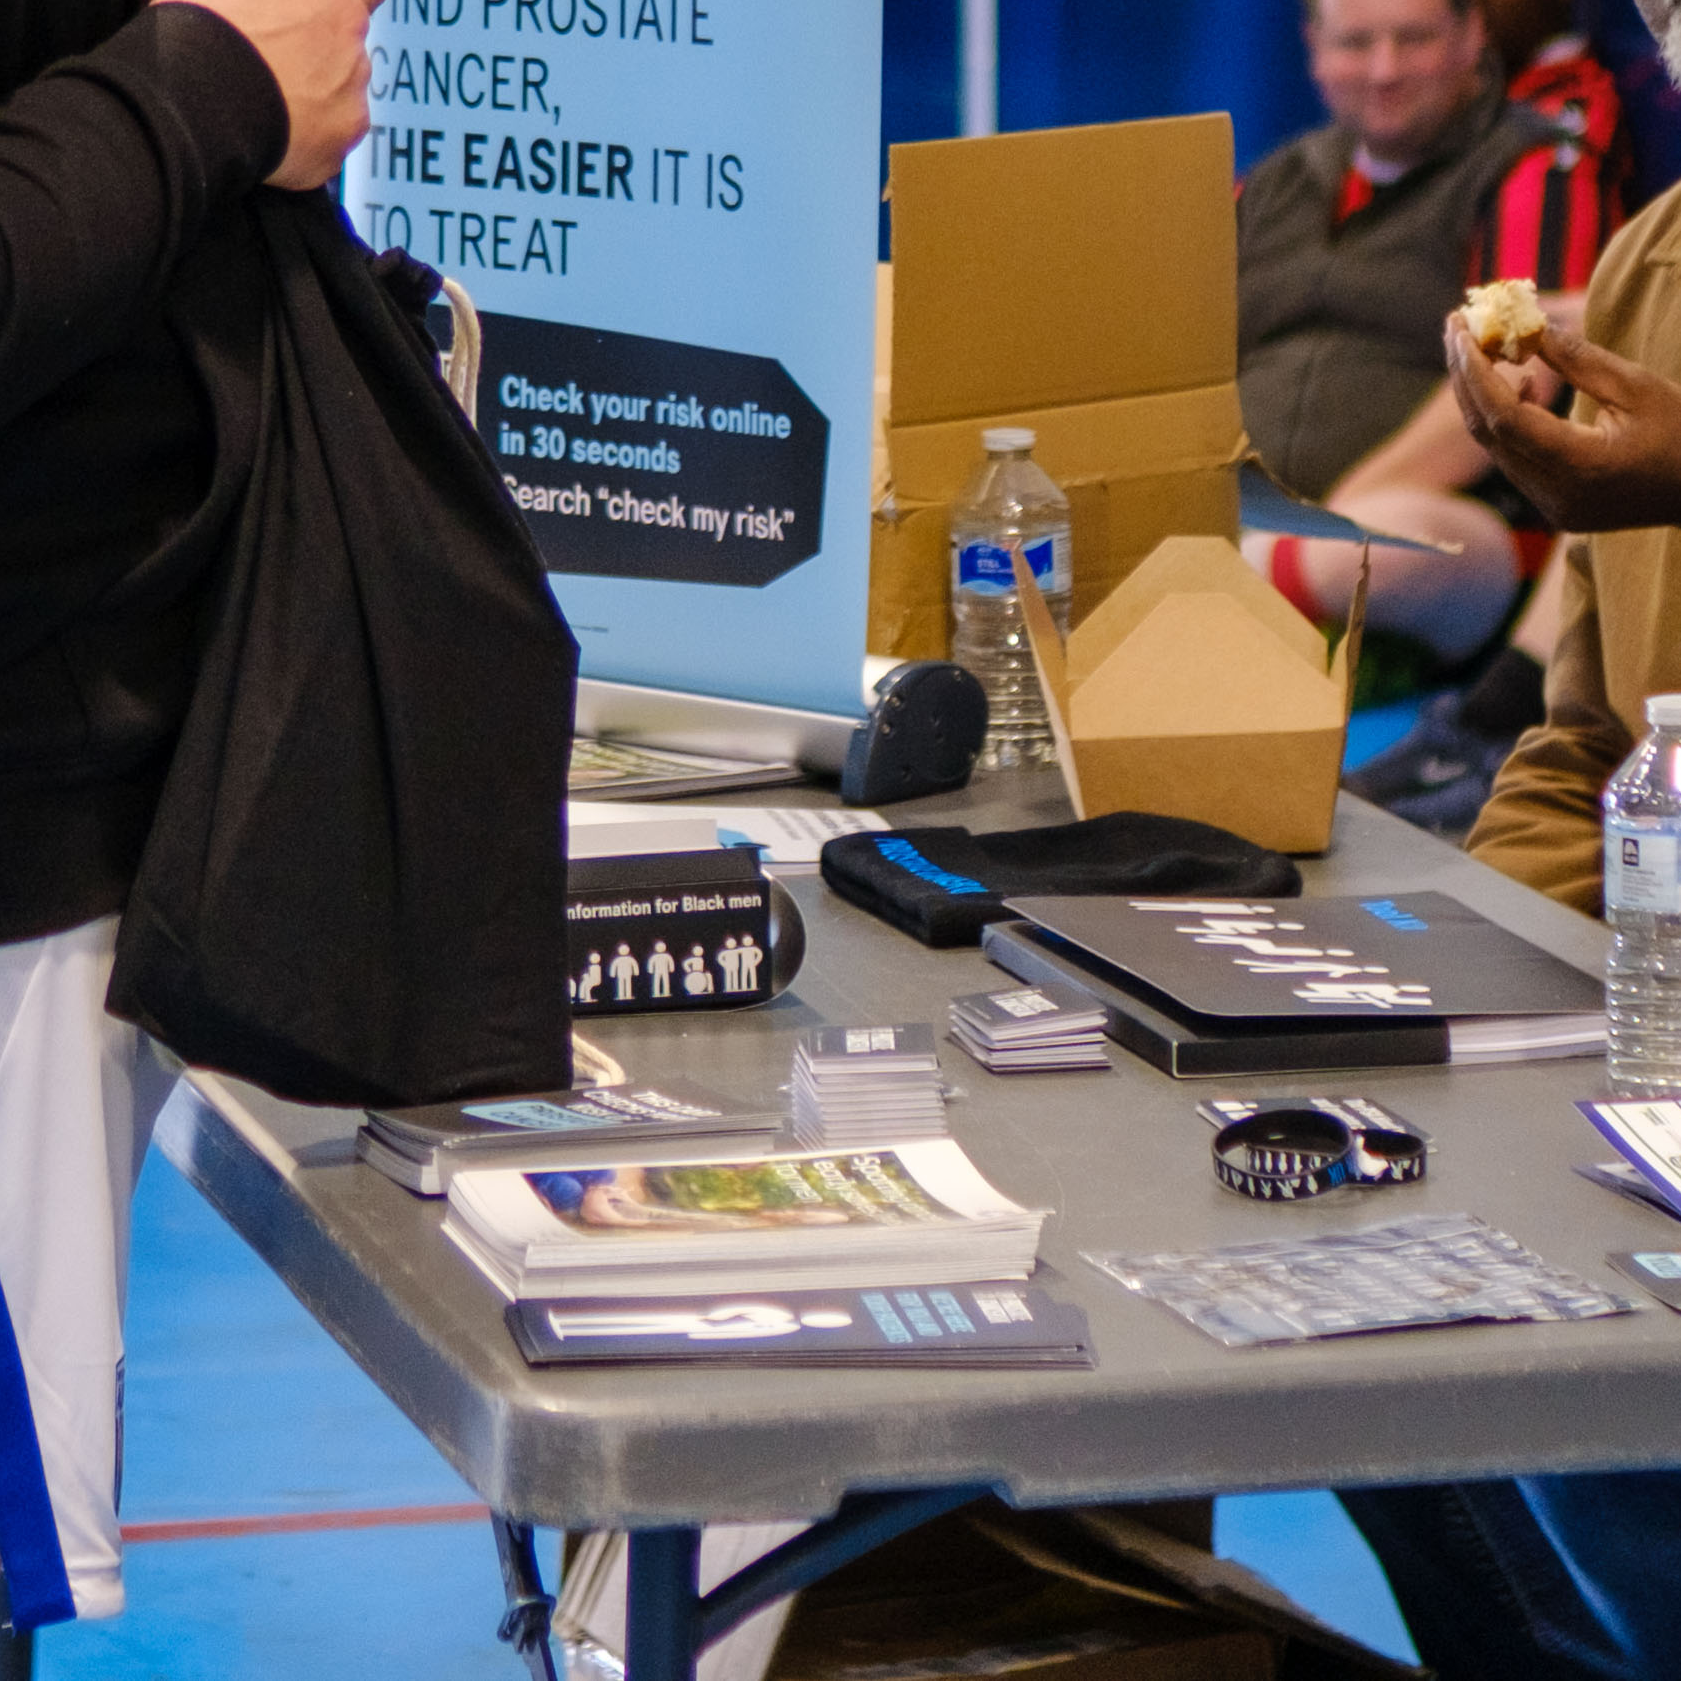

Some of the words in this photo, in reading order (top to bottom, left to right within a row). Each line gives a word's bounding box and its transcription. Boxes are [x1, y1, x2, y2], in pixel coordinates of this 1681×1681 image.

[371, 45, 562, 125] CANCER,
[369, 125, 445, 184] THE
[464, 133, 634, 201] EASIER
[651, 148, 689, 207] IT
[706, 154, 744, 211] IS
[365, 203, 412, 255] TO
[429, 209, 579, 275] TREAT
[500, 374, 584, 418] Check
[591, 385, 651, 428] your
[656, 386, 706, 429] risk
[710, 395, 793, 440] online
[499, 421, 526, 456] in
[530, 427, 567, 461] 30
[571, 433, 681, 476] seconds
[691, 501, 731, 545] my
[566, 899, 653, 920] nformation
[654, 896, 679, 915] for
[682, 893, 725, 913] Black
[727, 893, 763, 910] men
